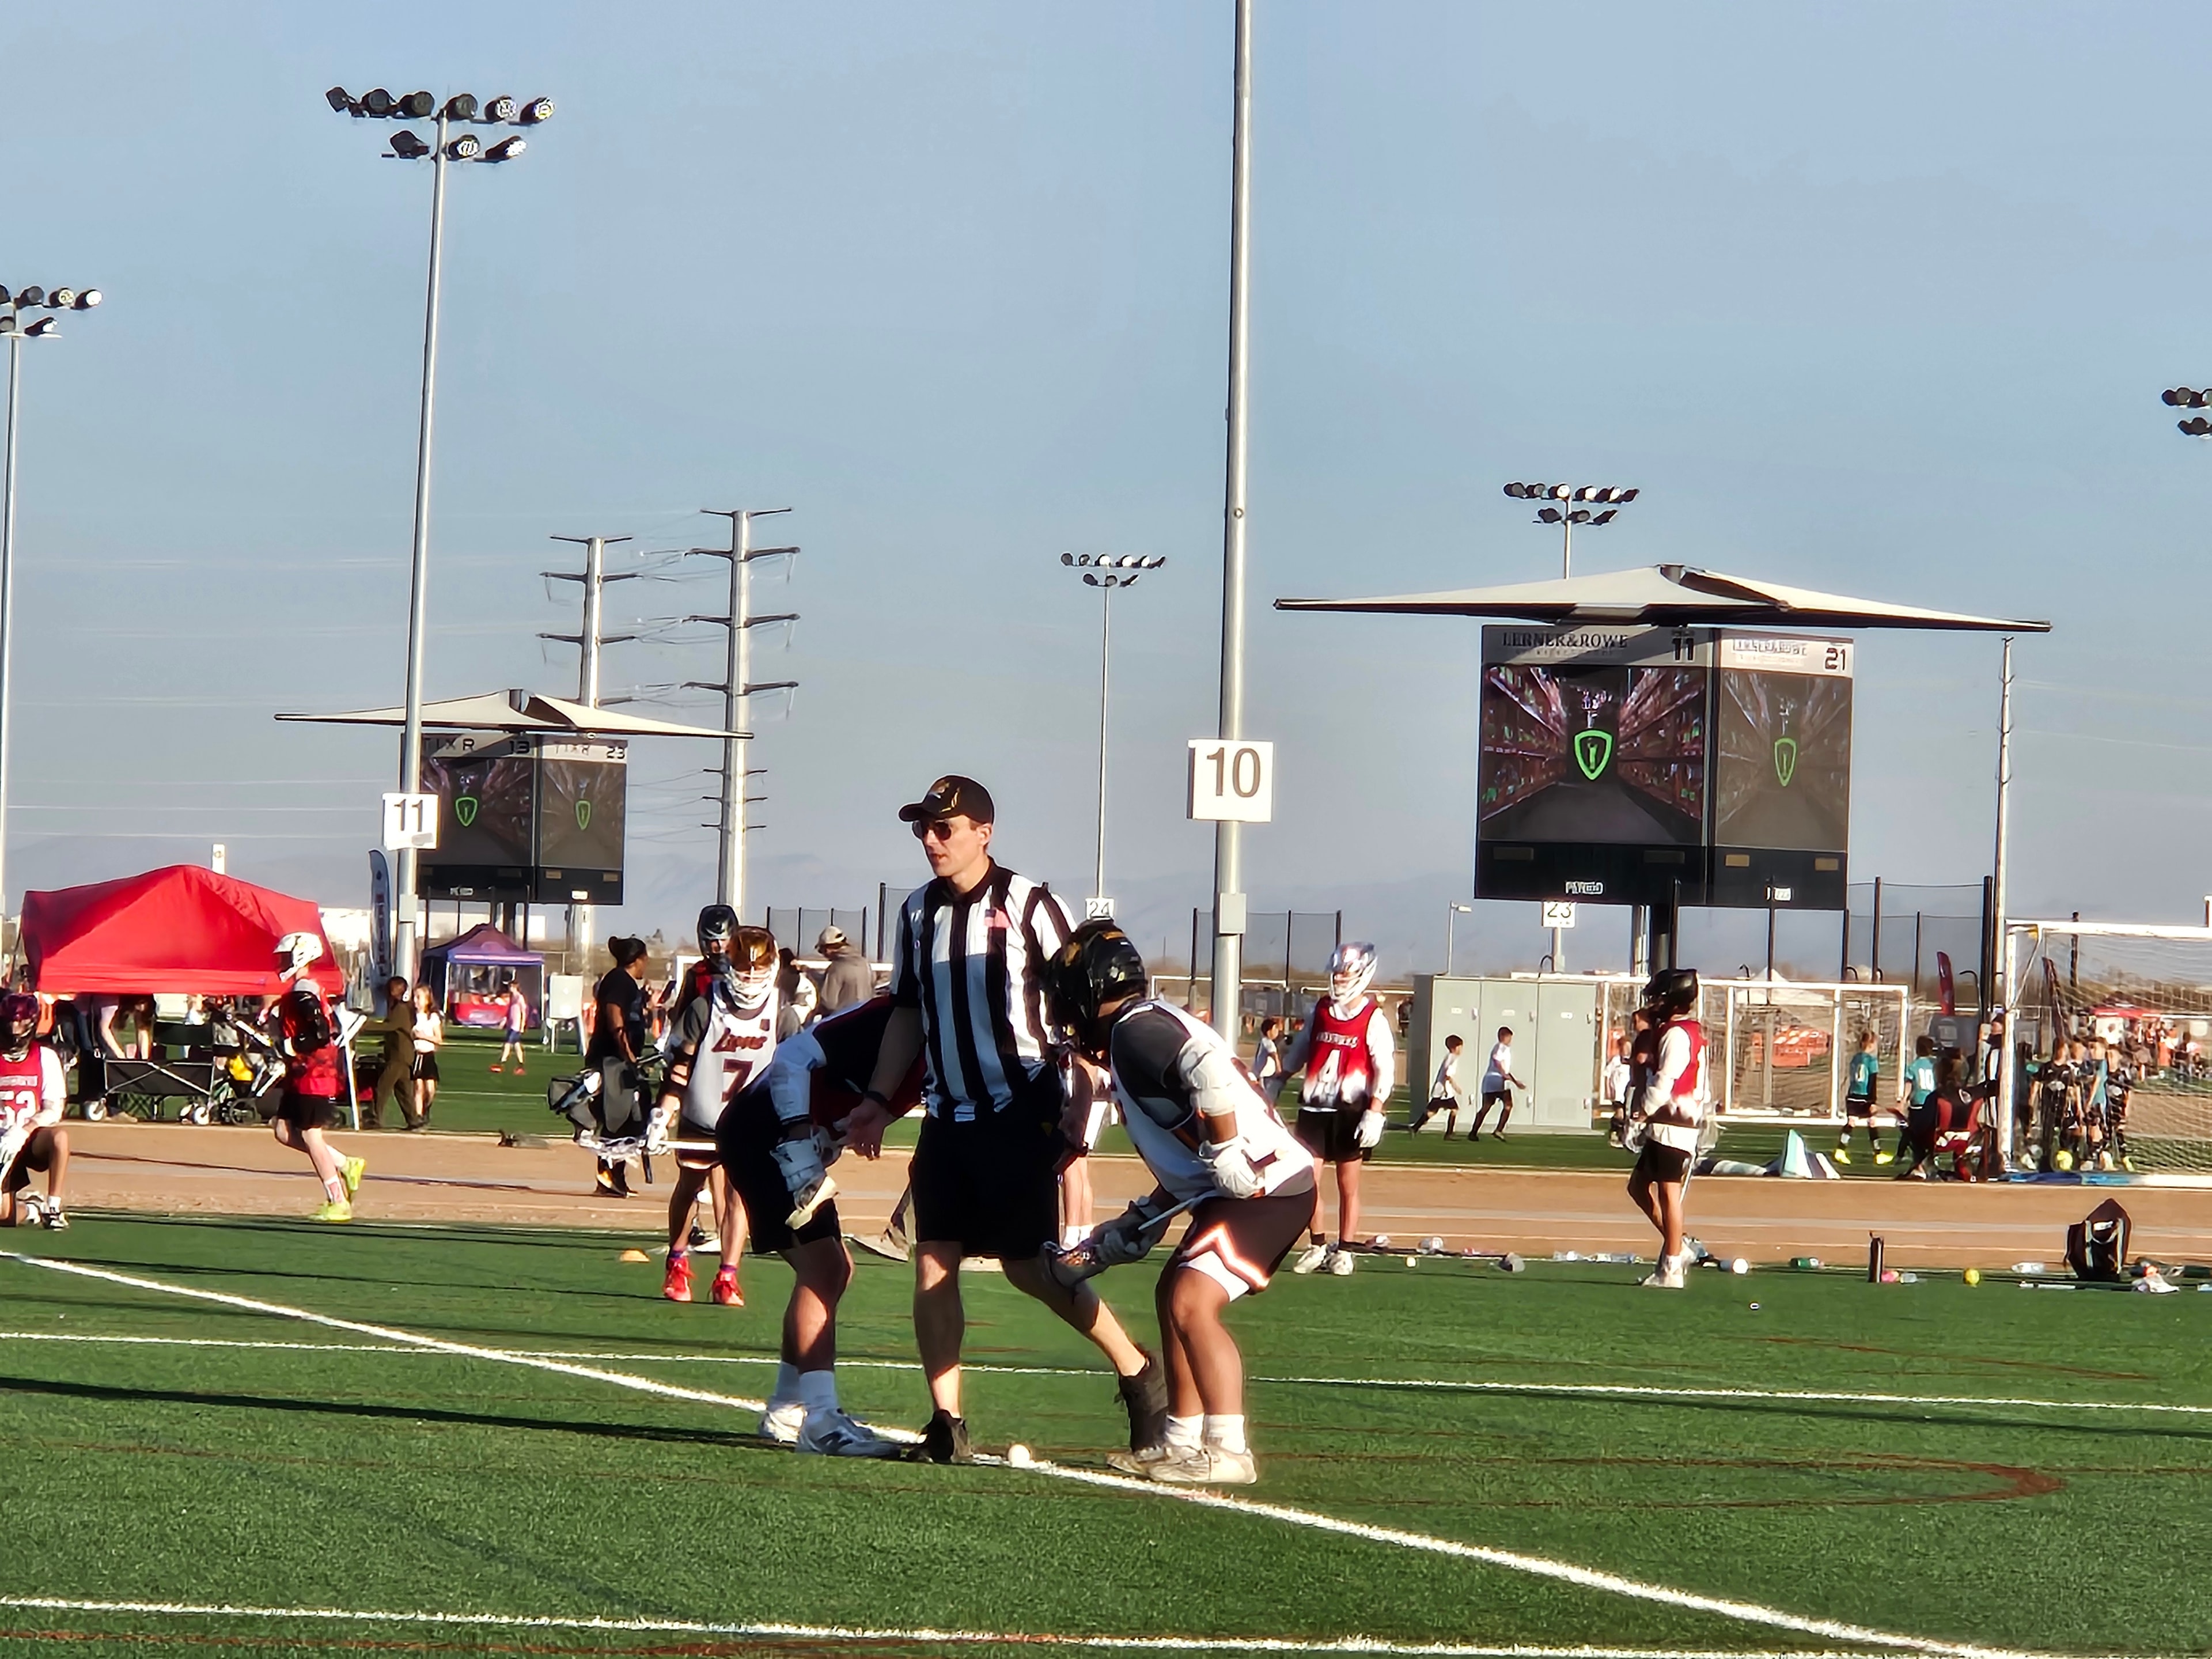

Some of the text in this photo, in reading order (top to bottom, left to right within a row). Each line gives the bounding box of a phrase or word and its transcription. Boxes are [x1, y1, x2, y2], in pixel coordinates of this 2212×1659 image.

[1672, 638, 1694, 661] 11
[1825, 647, 1846, 670] 21
[509, 740, 530, 754] 13
[607, 746, 625, 759] 23
[1207, 747, 1261, 798] 10
[393, 798, 423, 833] 11
[1089, 900, 1109, 917] 24
[722, 1058, 753, 1103] 7
